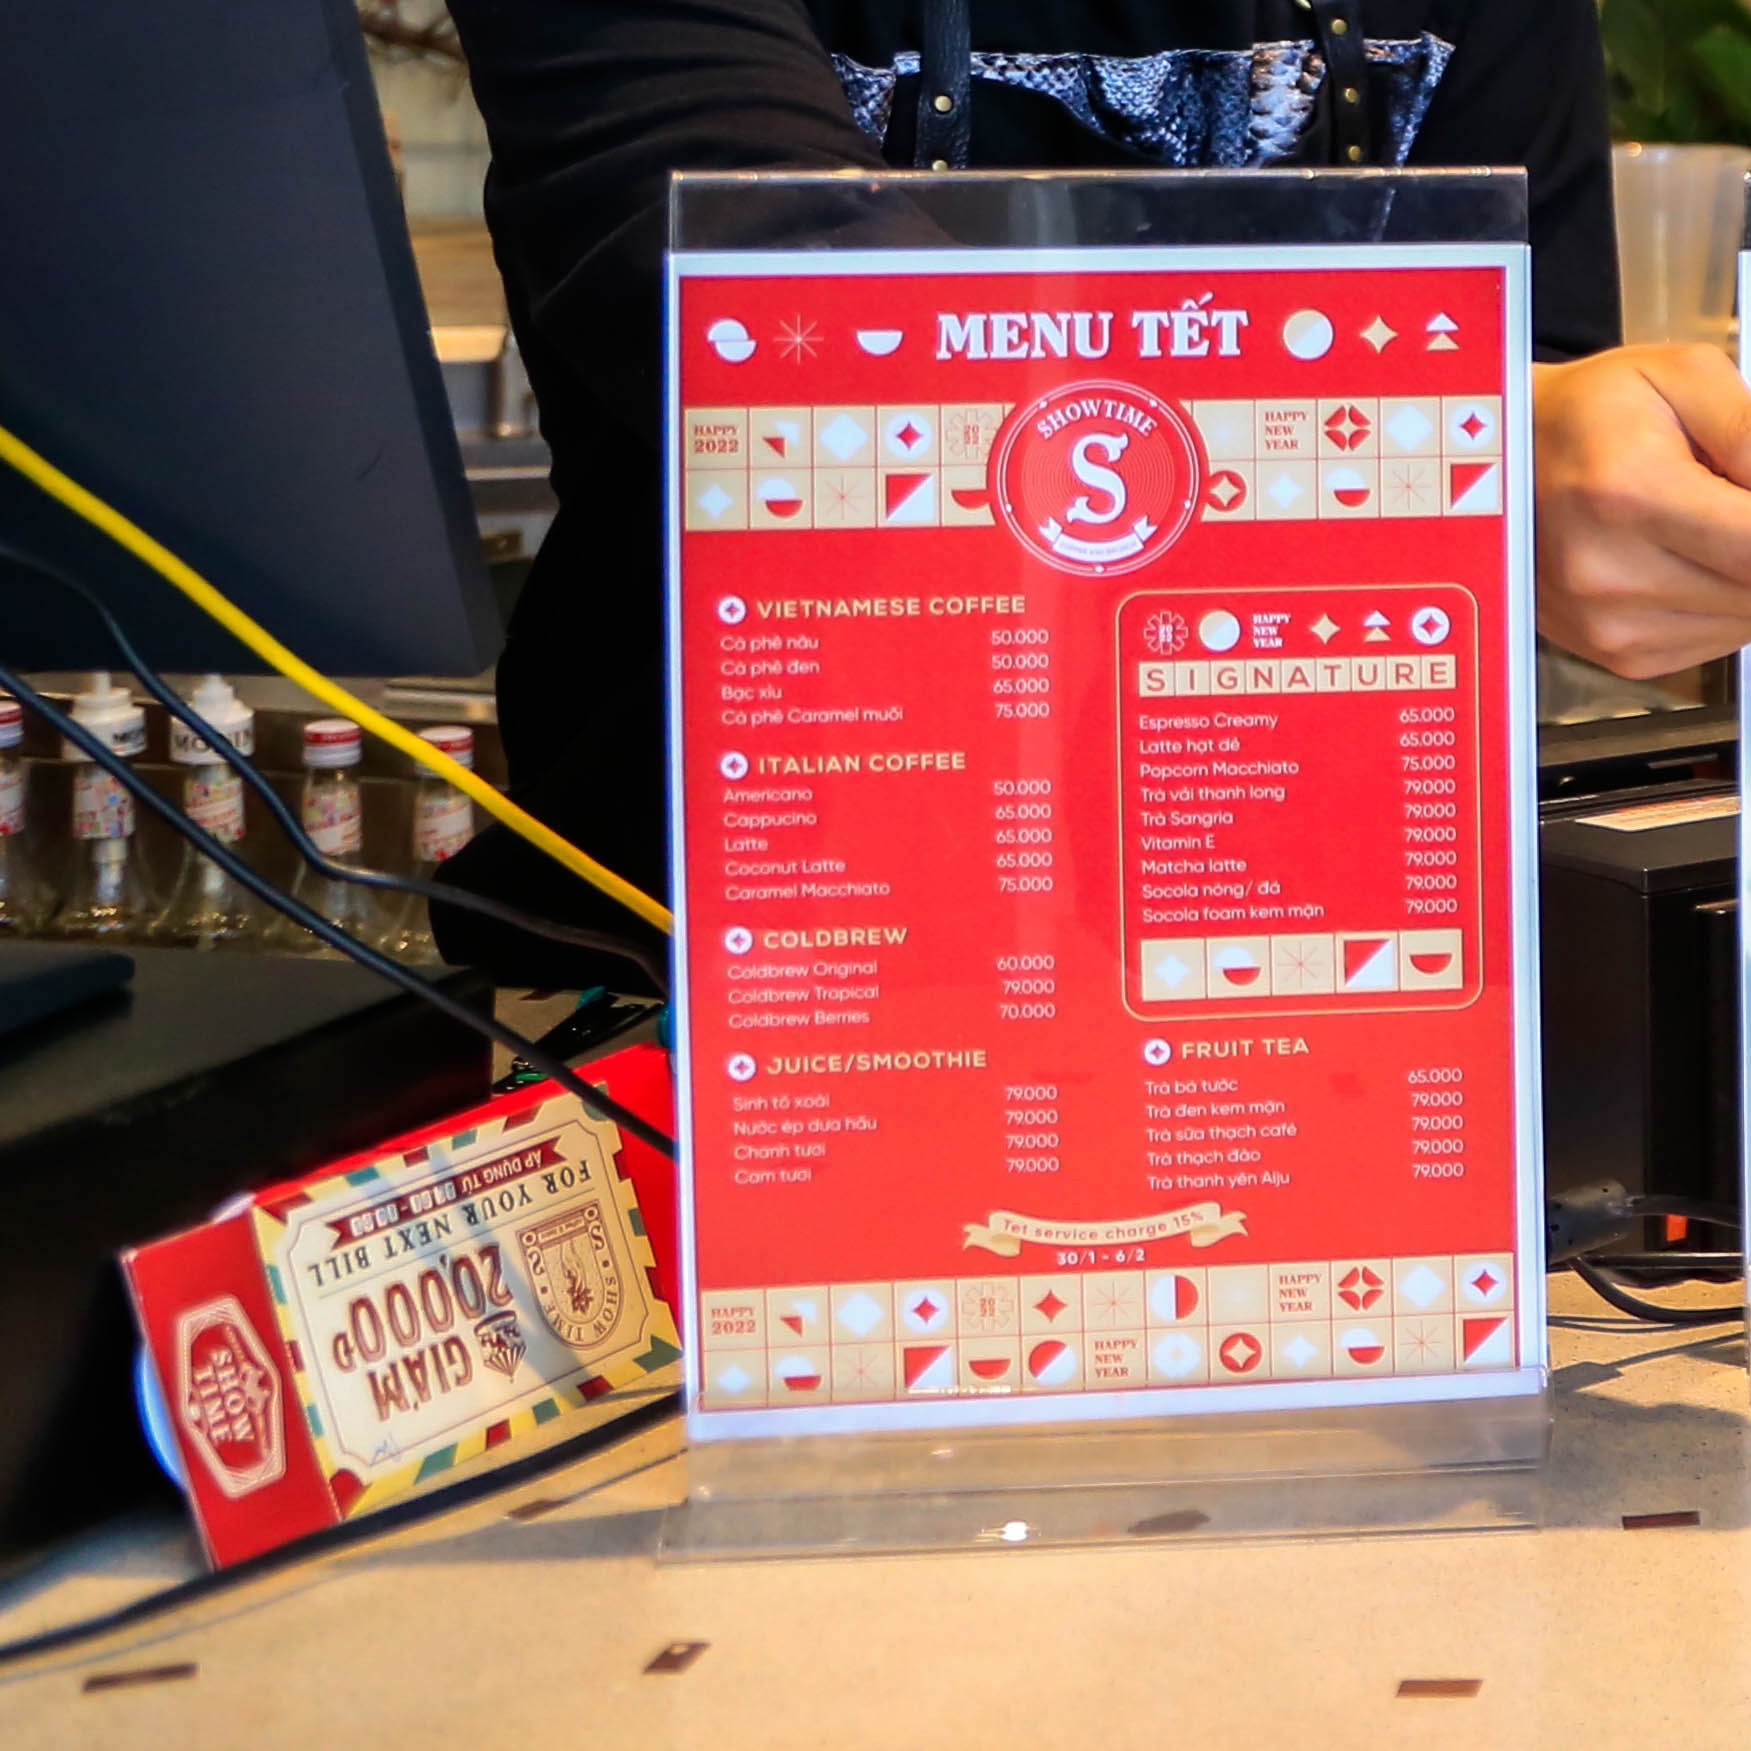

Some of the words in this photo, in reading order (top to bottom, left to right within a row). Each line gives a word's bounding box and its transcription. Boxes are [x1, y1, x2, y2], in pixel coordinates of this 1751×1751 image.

[936, 311, 1113, 361] MENU
[1132, 292, 1248, 358] TẾT
[1036, 399, 1158, 440] SHOWTIME
[1264, 410, 1309, 422] HAPPY
[693, 424, 738, 437] HAPPY
[1264, 425, 1295, 436] NEW
[693, 439, 739, 453] 2022
[1264, 438, 1298, 451] YEAR
[1066, 431, 1128, 524] S
[757, 599, 921, 619] VIETNAMESE
[929, 596, 1025, 615] COFFEE
[1253, 614, 1291, 624] HAPPY
[991, 630, 1049, 646] 50.000
[1253, 626, 1279, 636] NEW
[751, 635, 783, 654] phê
[1253, 638, 1283, 648] YEAR
[751, 659, 783, 678] phê
[787, 659, 820, 675] đen
[991, 654, 1049, 670] 50.000
[1147, 662, 1447, 692] SIGNATURE
[993, 678, 1050, 694] 65.000
[751, 709, 783, 728] phê
[787, 707, 859, 724] Caramel
[994, 703, 1050, 719] 75.000
[1399, 707, 1455, 724] 65.000
[1139, 715, 1209, 733] Espresso
[1214, 713, 1278, 729] Creamy
[1139, 740, 1182, 754] Latte
[1399, 731, 1455, 747] 65.000
[758, 755, 861, 775] ITALIAN
[868, 752, 966, 771] COFFEE
[1139, 763, 1208, 781] Popcorn
[1213, 761, 1299, 776] Macchiato
[1402, 755, 1456, 771] 75.000
[993, 780, 1051, 796] 50.000
[1199, 786, 1246, 800] thanh
[1249, 785, 1286, 802] long
[1404, 779, 1456, 795] 79.000
[723, 788, 813, 803] Americano
[995, 805, 1052, 821] 65.000
[1170, 810, 1234, 828] Sangria
[1404, 803, 1456, 819] 79.000
[723, 813, 817, 830] Cappucino
[996, 829, 1052, 845] 65.000
[1141, 836, 1201, 850] Vitamin
[1205, 834, 1216, 849] E
[1404, 827, 1456, 843] 79.000
[724, 838, 768, 853] Latte
[996, 853, 1052, 869] 65.000
[1141, 859, 1204, 875] Matcha
[1209, 858, 1247, 872] latte
[1405, 851, 1457, 867] 79.000
[725, 860, 797, 877] Coconut
[802, 858, 846, 874] Latte
[725, 884, 797, 901] Caramel
[801, 881, 890, 898] Macchiato
[998, 876, 1053, 892] 75.000
[1142, 883, 1198, 899] Socola
[1405, 875, 1457, 891] 79.000
[1142, 907, 1199, 923] Socola
[1203, 905, 1246, 921] foam
[1249, 904, 1284, 919] kem
[1406, 899, 1458, 915] 79.000
[763, 927, 908, 949] COLDBREW
[727, 964, 810, 981] Coldbrew
[813, 961, 878, 979] Original
[997, 955, 1054, 972] 60.000
[728, 988, 810, 1005] Coldbrew
[814, 985, 879, 1004] Tropical
[1002, 979, 1055, 995] 79.000
[999, 1003, 1055, 1020] 70.000
[729, 1012, 810, 1029] Coldbrew
[1181, 1040, 1255, 1059] FRUIT
[1262, 1037, 1310, 1055] TEA
[766, 1049, 987, 1076] JUICE/SMOOTHIE
[1408, 1068, 1463, 1084] 65.000
[1005, 1086, 1057, 1102] 79.000
[1411, 1092, 1463, 1108] 79.000
[732, 1096, 768, 1112] Sinh
[1175, 1103, 1207, 1118] đen
[1211, 1101, 1245, 1116] kem
[1005, 1110, 1058, 1126] 79.000
[1411, 1115, 1464, 1131] 79.000
[1005, 1134, 1058, 1150] 79.000
[1411, 1139, 1464, 1155] 79.000
[733, 1143, 790, 1160] Chanh
[1006, 1158, 1060, 1174] 79.000
[1412, 1163, 1464, 1178] 79.000
[546, 1159, 592, 1196] FOR
[734, 1169, 776, 1185] Cam
[1177, 1173, 1224, 1189] thanh
[463, 1182, 534, 1227] YOUR
[384, 1208, 454, 1258] NEXT
[1034, 1226, 1099, 1241] service
[1105, 1221, 1167, 1238] charge
[1173, 1212, 1204, 1229] 15%
[1057, 1251, 1096, 1266] 30/1
[1115, 1249, 1145, 1264] 6/2
[308, 1244, 371, 1288] BILL
[1278, 1273, 1323, 1286] HAPPY
[1278, 1287, 1309, 1299] NEW
[588, 1275, 618, 1340] SHOW
[710, 1306, 754, 1318] HAPPY
[1279, 1301, 1313, 1313] YEAR
[541, 1301, 585, 1343] TIME
[711, 1320, 756, 1335] 2022
[1094, 1338, 1138, 1351] HAPPY
[1094, 1353, 1123, 1364] NEW
[1095, 1367, 1129, 1378] YEAR
[211, 1349, 254, 1442] SHOW
[194, 1365, 222, 1445] TIME
